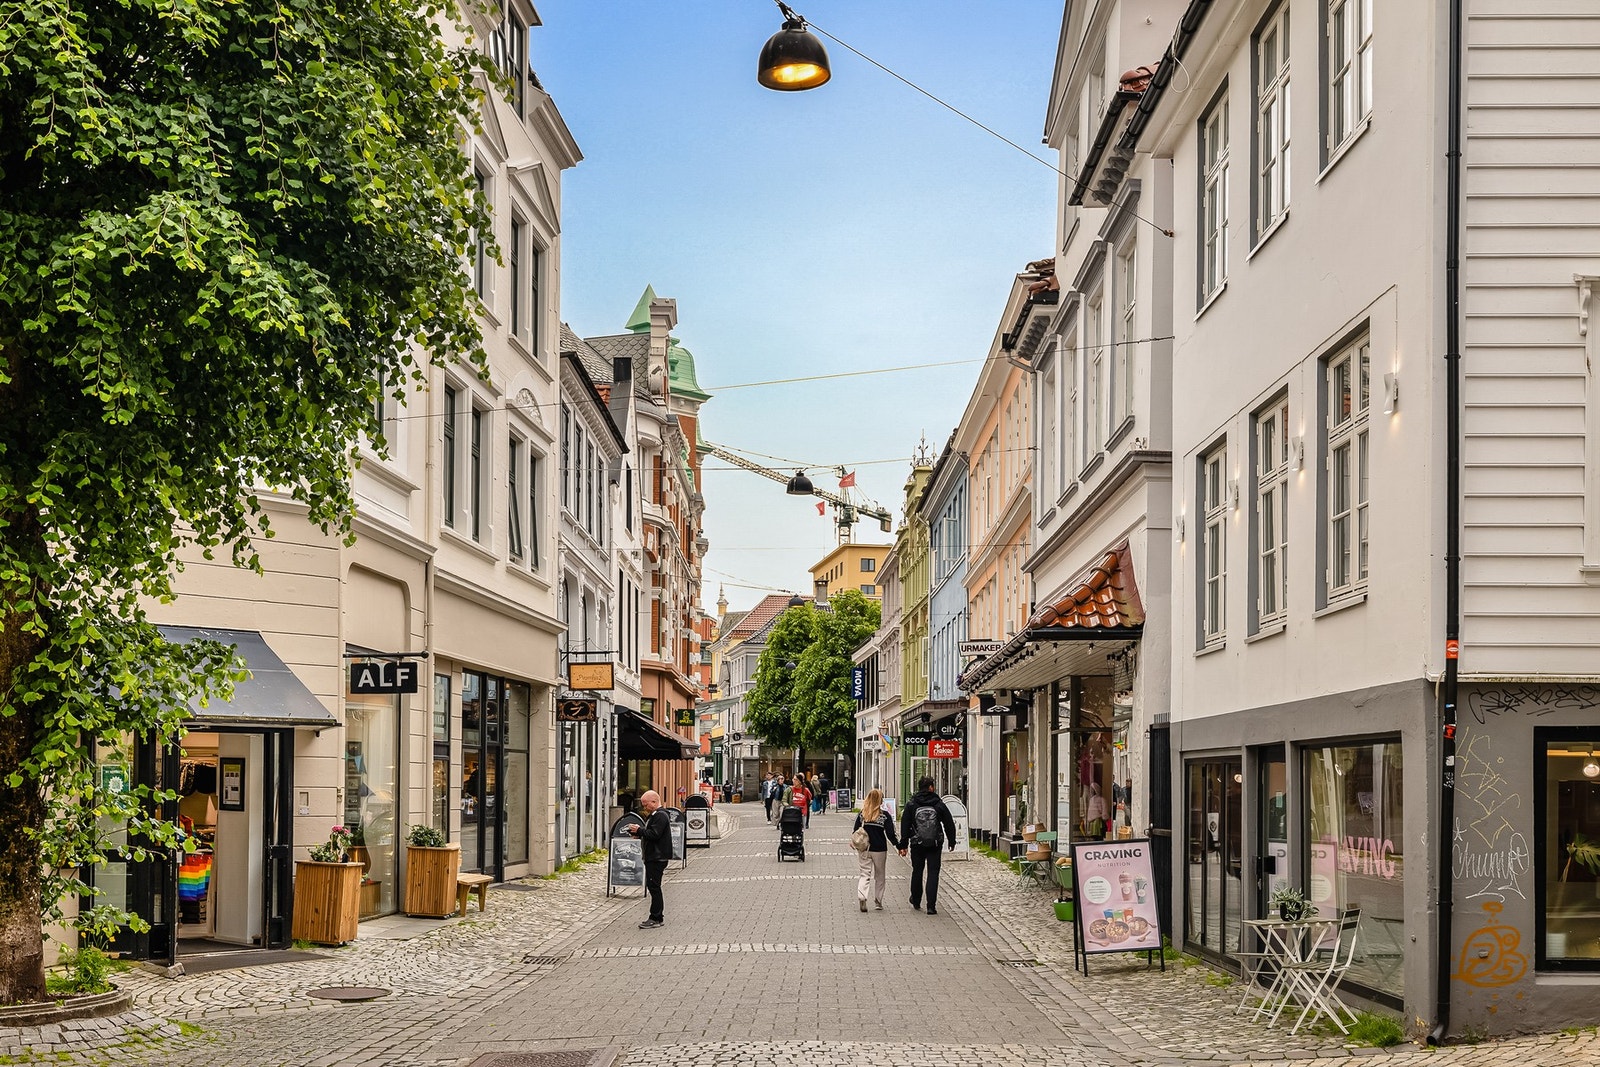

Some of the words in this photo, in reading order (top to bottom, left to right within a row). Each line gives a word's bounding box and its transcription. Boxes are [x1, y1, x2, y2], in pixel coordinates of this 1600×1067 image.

[961, 644, 1001, 653] URMAKER
[357, 662, 410, 688] ALF
[854, 670, 862, 697] MOVA
[941, 725, 957, 736] city
[1084, 848, 1142, 861] CRAVING
